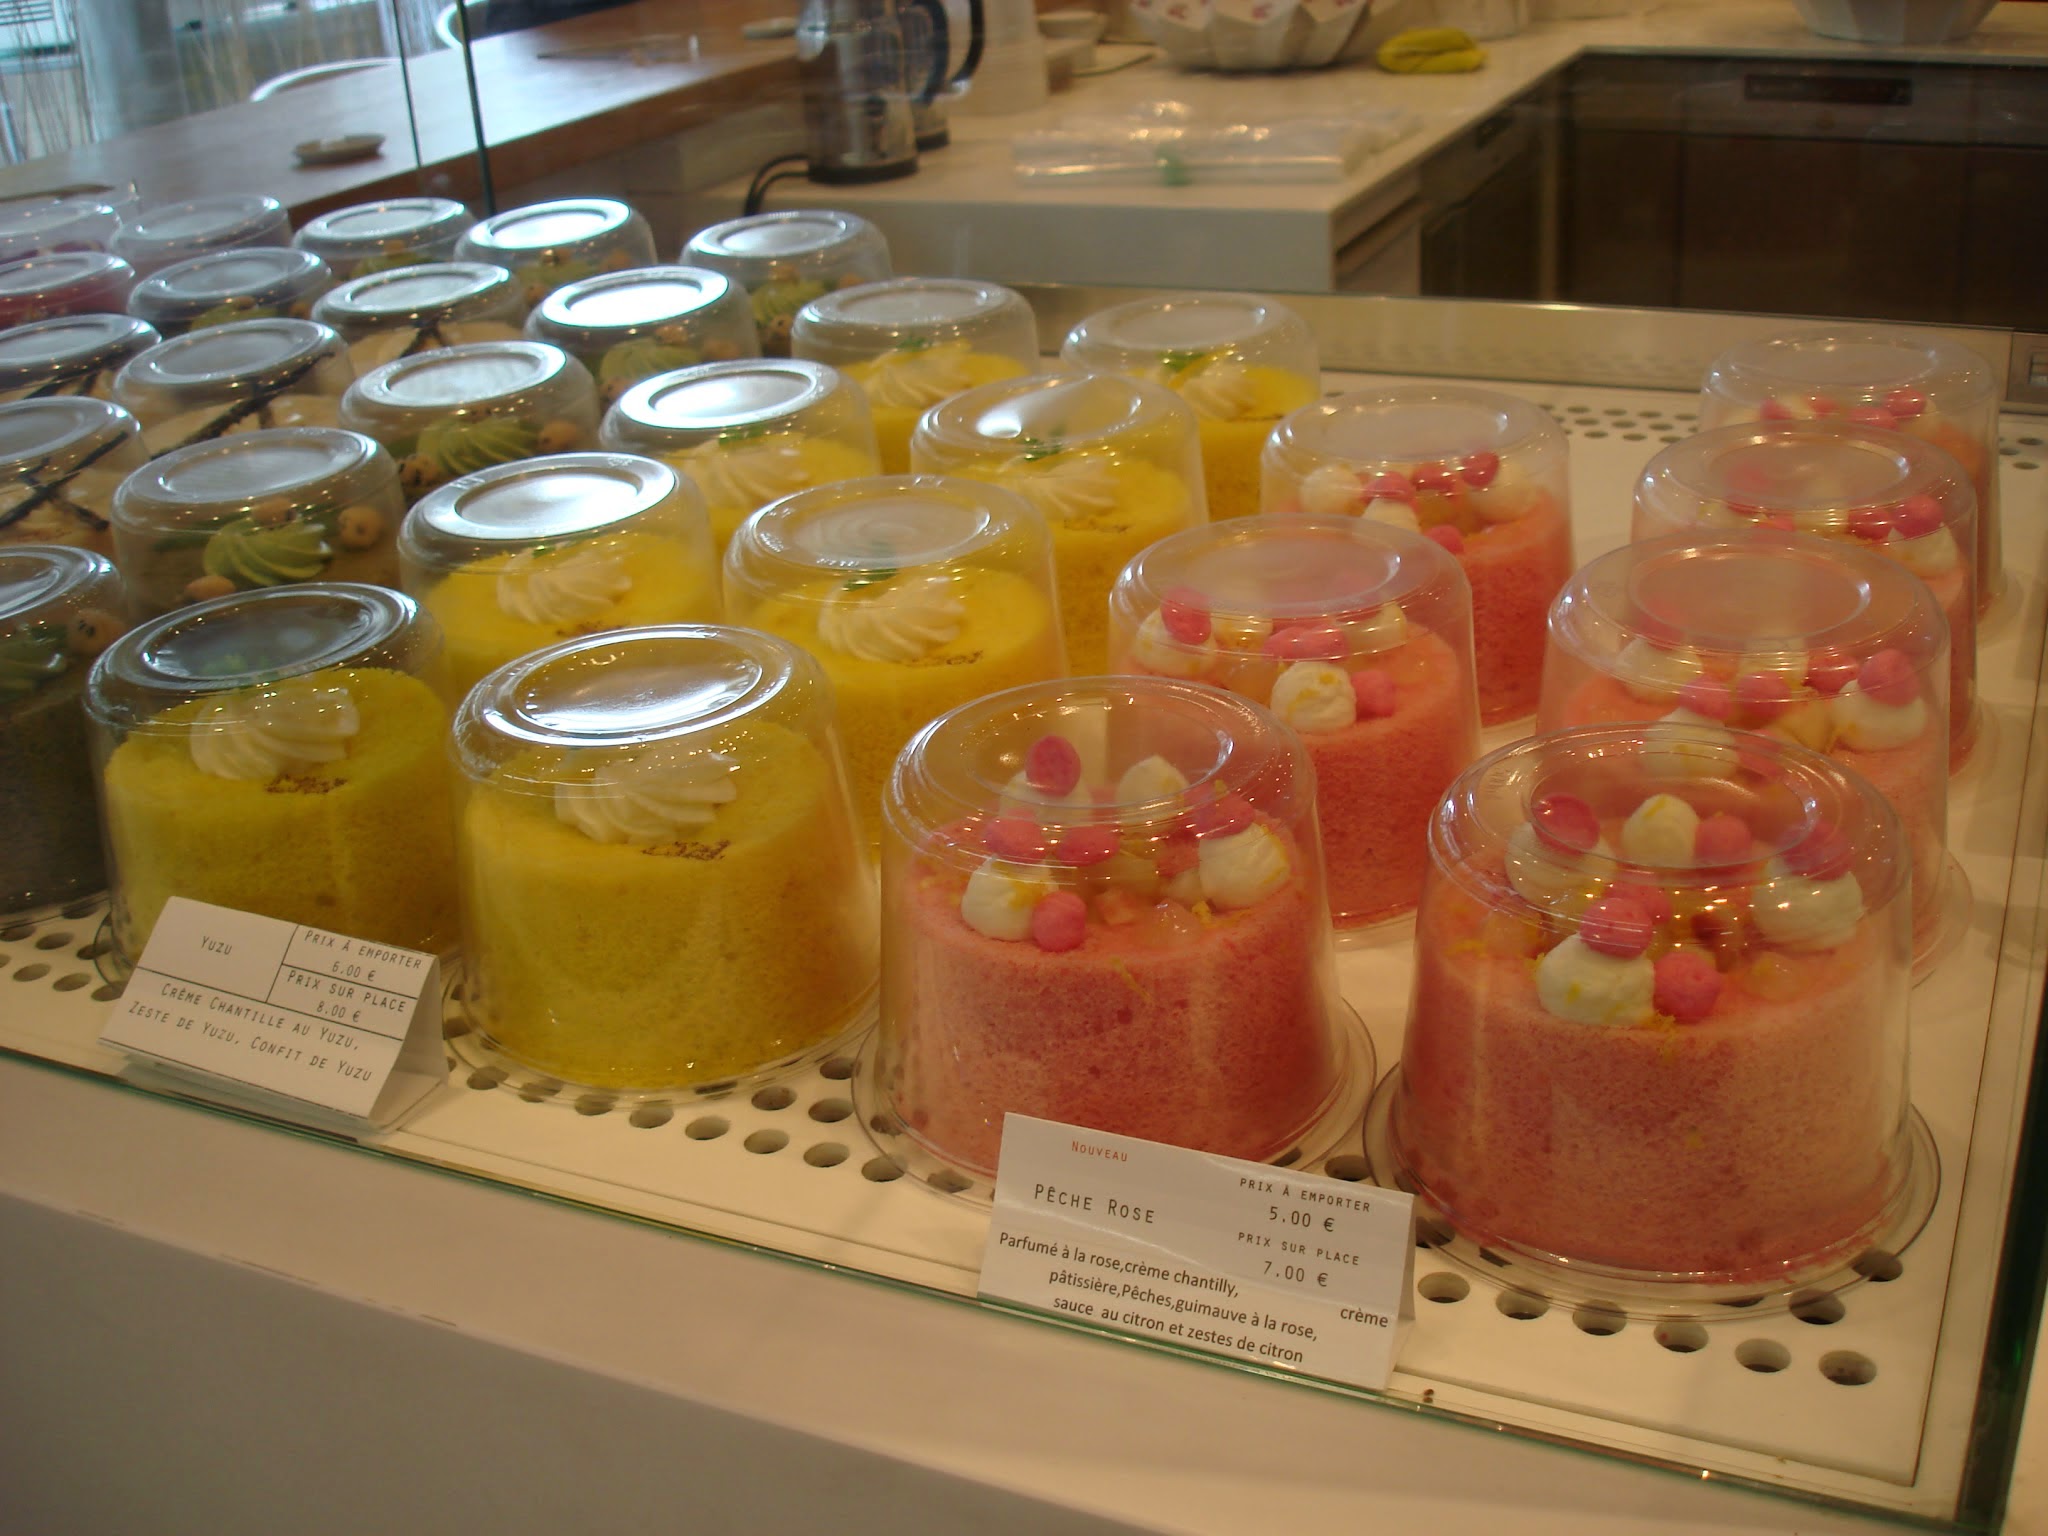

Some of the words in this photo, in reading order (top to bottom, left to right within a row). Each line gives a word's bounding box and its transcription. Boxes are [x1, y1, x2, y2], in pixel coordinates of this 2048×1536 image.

[201, 936, 233, 956] YUZU
[304, 930, 335, 947] PRIX
[358, 946, 423, 970] EMPORTER
[331, 961, 362, 979] 6.00
[367, 969, 376, 983] €
[287, 970, 321, 990] PRIX
[328, 983, 355, 1000] SUR
[364, 992, 408, 1013] PLACE
[210, 996, 285, 1029] CHANTILLE
[292, 1023, 311, 1037] AU
[319, 1027, 359, 1051] YUZU,
[316, 1001, 346, 1019] 8.00
[352, 1010, 361, 1024] €
[128, 1001, 170, 1024] ZESTE
[176, 1015, 195, 1030] DE
[202, 1021, 240, 1045] YUZU,
[251, 1036, 303, 1062] CONFIT
[309, 1054, 328, 1069] DE
[336, 1061, 373, 1082] YUZU
[1071, 1140, 1129, 1163] NOUVEAU
[1034, 1183, 1094, 1212] PÊCHE
[1107, 1201, 1156, 1225] ROSE
[1239, 1177, 1274, 1195] PRIX
[1300, 1189, 1371, 1213] EMPORTER
[1269, 1206, 1312, 1229] 5.00
[1323, 1217, 1336, 1233] €
[1237, 1231, 1272, 1248] PRIX
[1280, 1240, 1307, 1255] SUR
[1316, 1247, 1361, 1266] PLACE
[999, 1231, 1058, 1258] Parfumé
[1061, 1242, 1070, 1259] à
[1073, 1246, 1087, 1264] la
[1173, 1268, 1240, 1299] chantilly,
[1339, 1305, 1390, 1329] crème
[1263, 1261, 1306, 1283] 7.00
[1317, 1271, 1329, 1288] €
[1053, 1297, 1094, 1317] sauce
[1101, 1304, 1119, 1322] au
[1122, 1310, 1166, 1333] citron
[1169, 1320, 1184, 1336] et
[1187, 1326, 1233, 1346] zestes
[1236, 1334, 1257, 1353] de
[1259, 1339, 1304, 1364] citron
[1251, 1311, 1260, 1328] à
[1263, 1314, 1277, 1332] la
[1280, 1320, 1319, 1342] rose,
